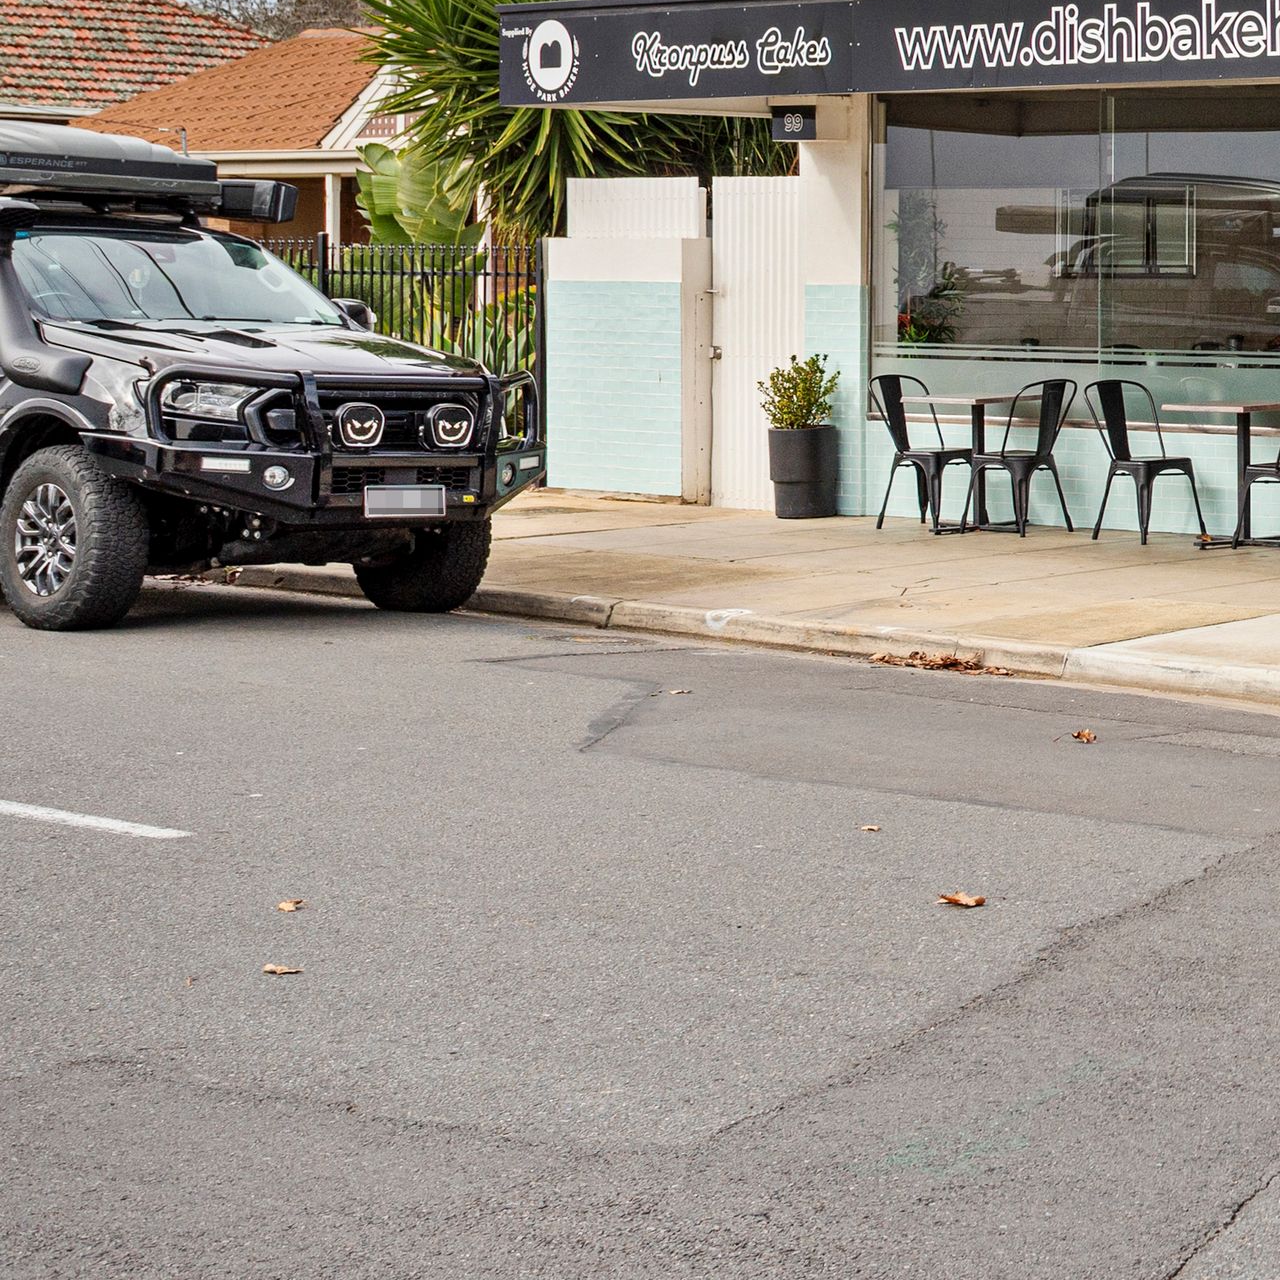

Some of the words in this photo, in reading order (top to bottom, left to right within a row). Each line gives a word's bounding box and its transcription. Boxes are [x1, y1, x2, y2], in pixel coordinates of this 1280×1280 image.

[502, 28, 525, 38] Supplied
[525, 27, 533, 37] By
[631, 31, 750, 87] Kronpuss
[756, 26, 832, 75] Cakes
[522, 61, 536, 92] HYDE
[536, 89, 558, 102] PARK
[559, 59, 580, 98] BAKERY
[784, 113, 804, 133] 99
[9, 156, 74, 169] ESPERANCE
